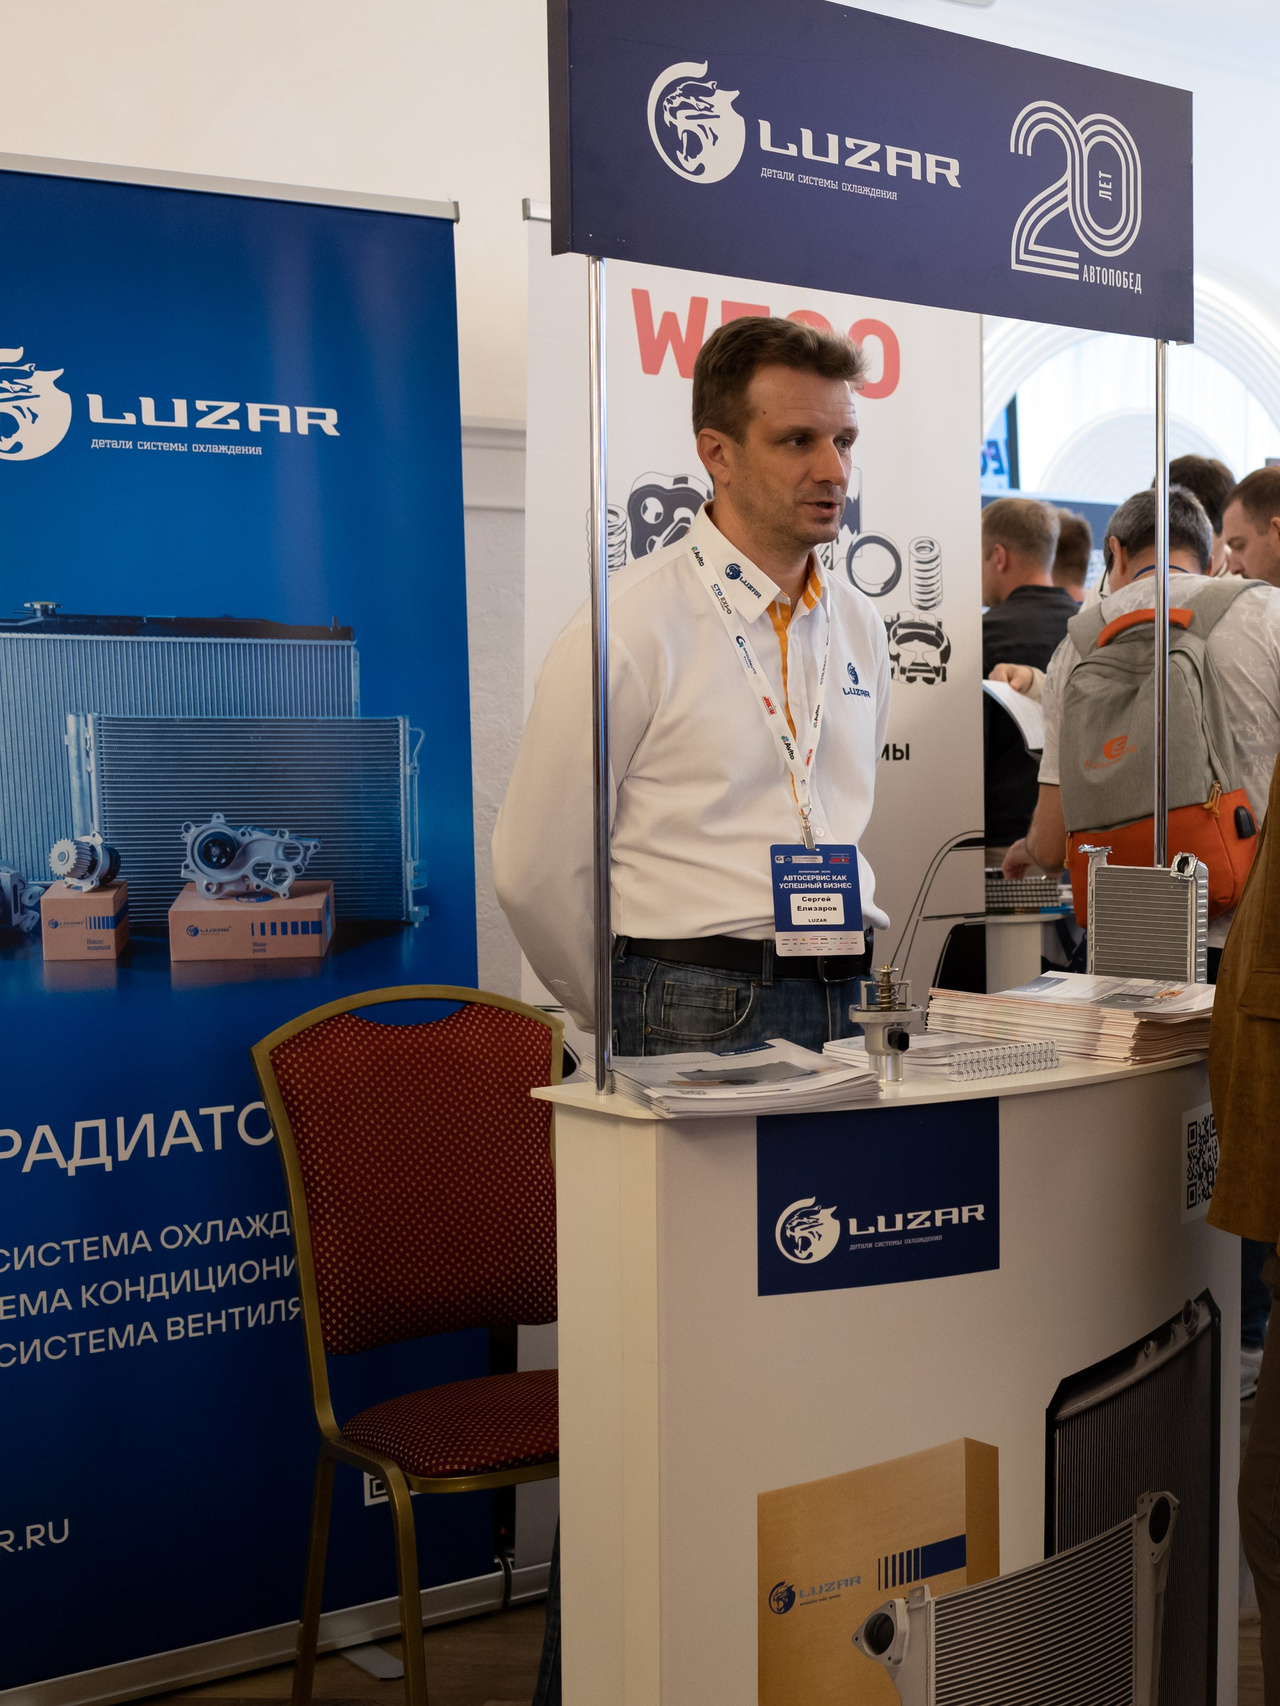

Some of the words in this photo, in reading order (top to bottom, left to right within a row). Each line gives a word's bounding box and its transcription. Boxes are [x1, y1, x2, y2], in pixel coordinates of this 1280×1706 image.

[758, 119, 962, 189] LUZAR
[760, 167, 795, 183] детали
[797, 173, 839, 191] системы
[841, 181, 898, 201] охлаждения
[1010, 100, 1142, 281] 20
[1099, 170, 1113, 201] ЛЕТ
[1082, 264, 1143, 295] АВТОПОБЕД
[631, 288, 901, 399] WO
[86, 393, 340, 436] LUZAR
[91, 437, 133, 452] детали
[137, 440, 188, 453] системы
[192, 441, 263, 455] охлаждения
[785, 742, 795, 760] Avito
[779, 881, 822, 889] УСПЕШНЫЙ
[802, 895, 831, 903] Сергей
[797, 905, 837, 913] Елизаров
[849, 1204, 985, 1236] LUZAR
[849, 1241, 873, 1251] детали
[874, 1238, 902, 1248] системы
[904, 1234, 943, 1246] охлаждения
[0, 1321, 157, 1367] СИСТЕМА
[800, 1576, 861, 1598] LUZAR
